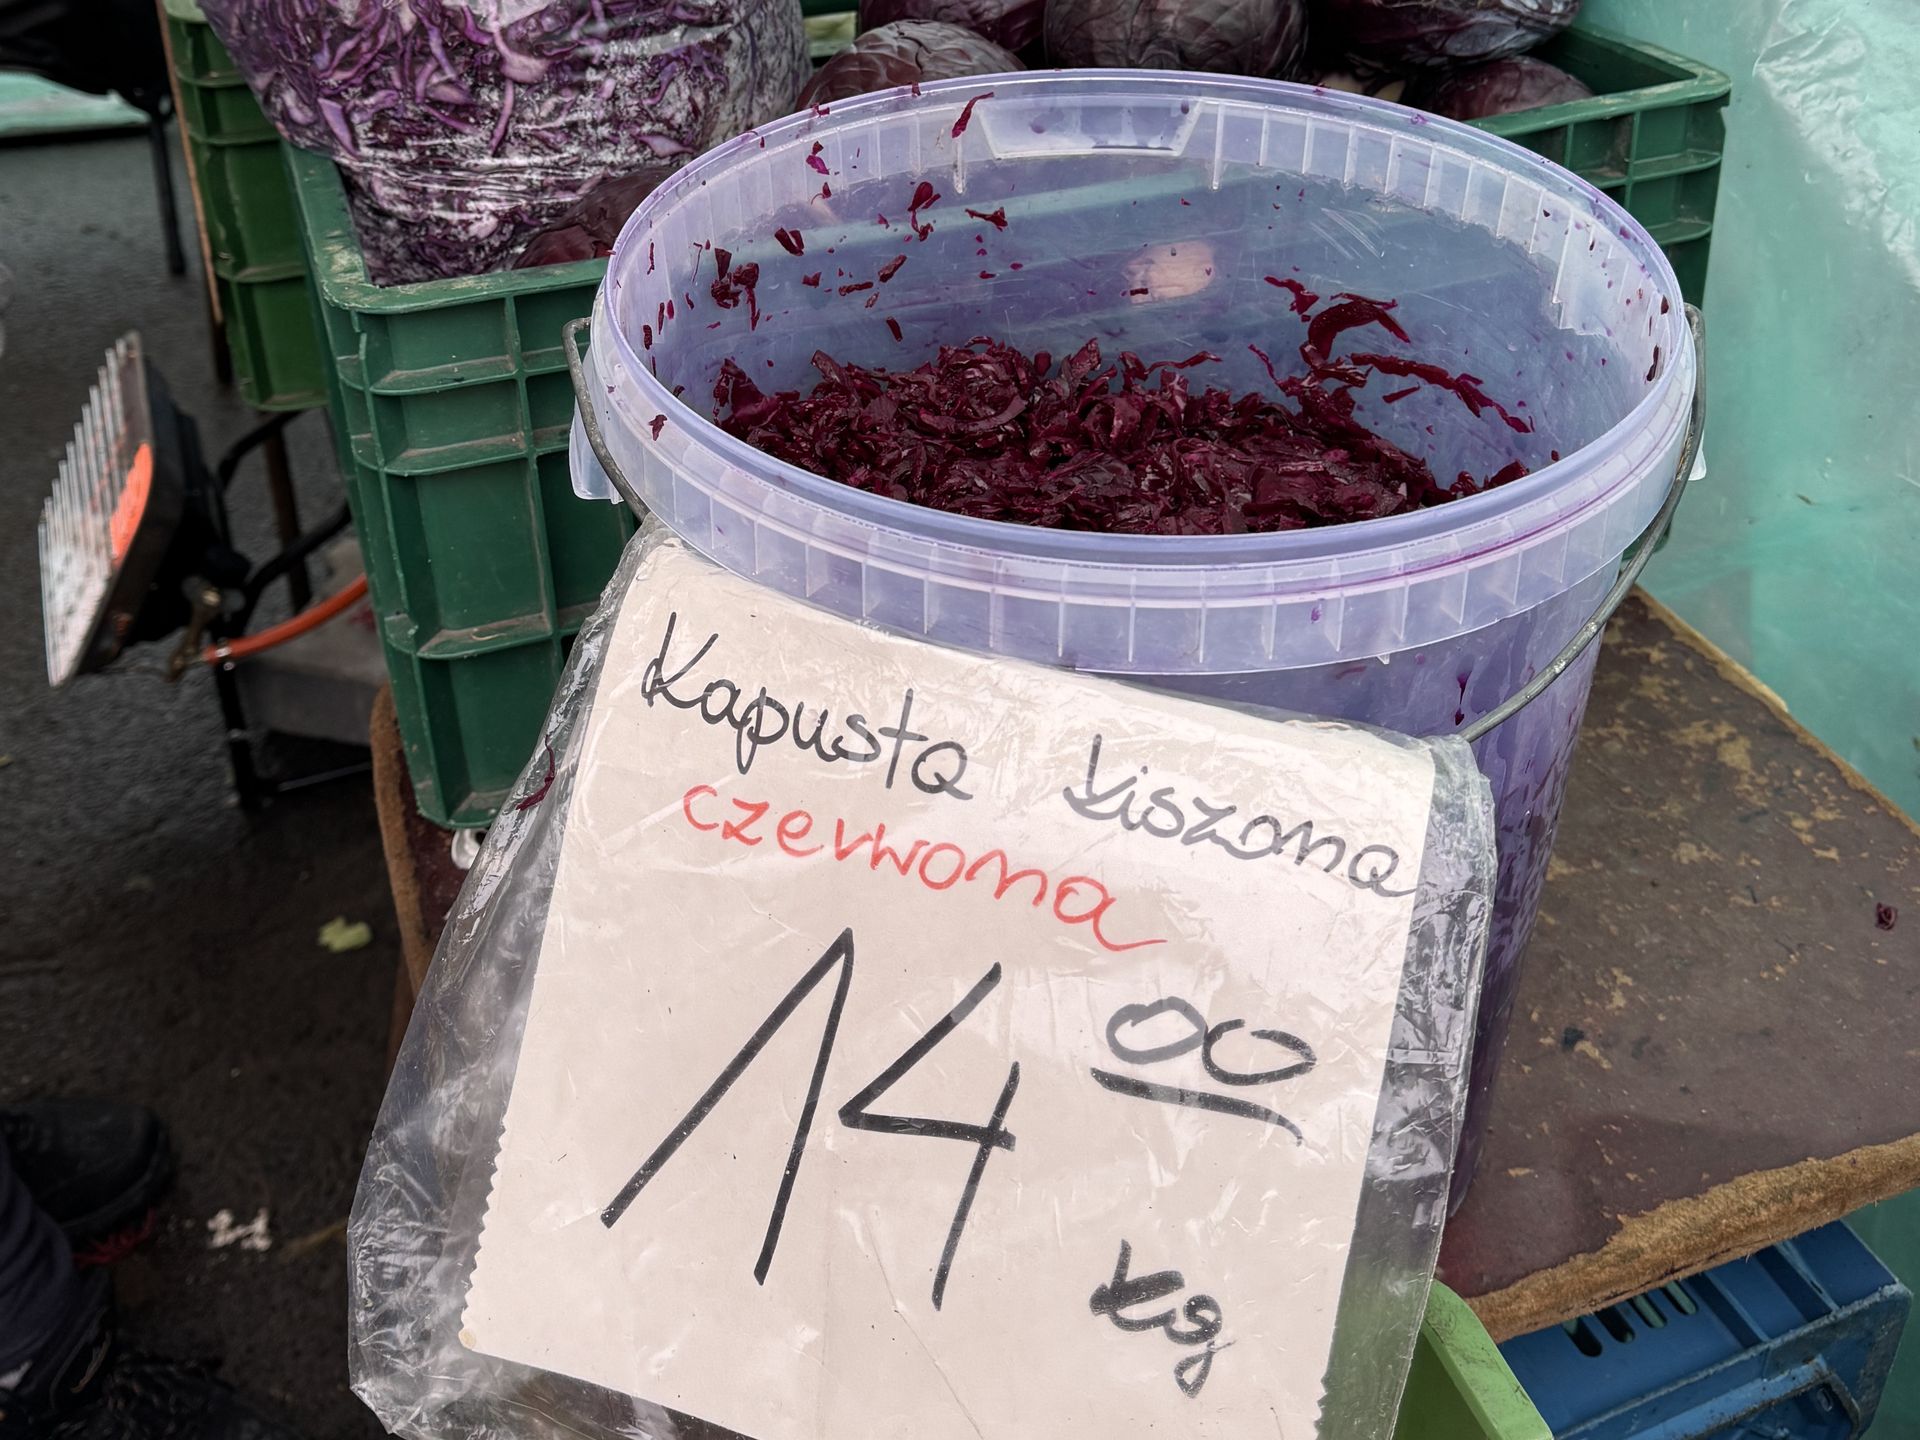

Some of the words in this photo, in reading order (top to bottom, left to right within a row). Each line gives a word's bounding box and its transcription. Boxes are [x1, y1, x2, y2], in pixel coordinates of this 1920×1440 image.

[641, 610, 974, 801] Kapusta
[682, 783, 1169, 953] czerwona
[600, 927, 1017, 1311] 14
